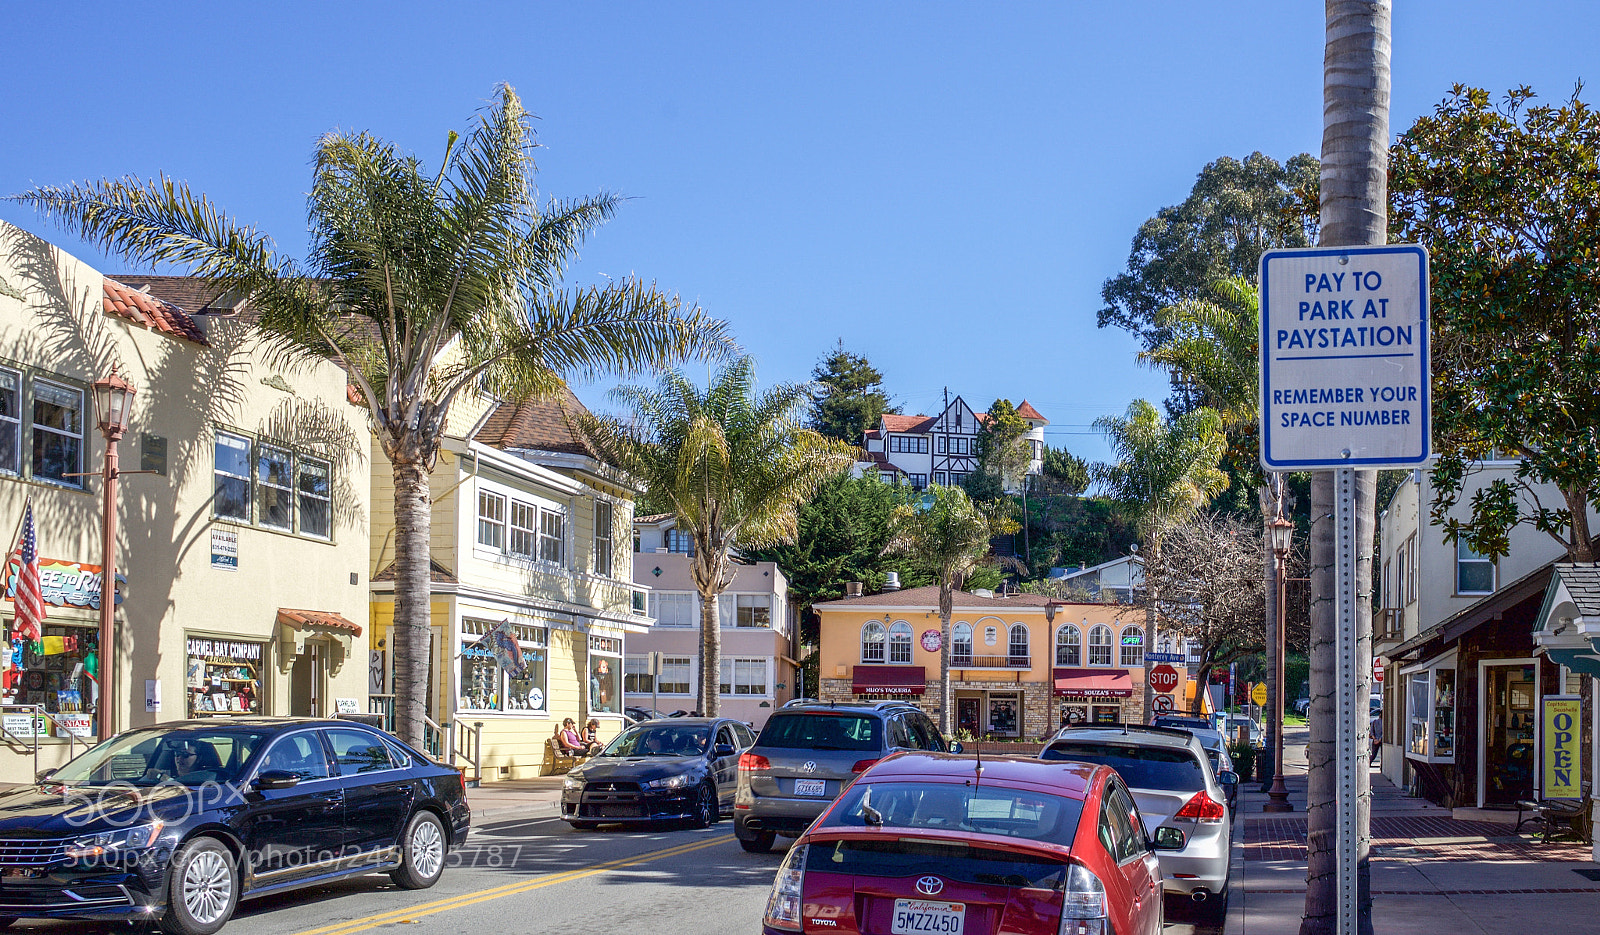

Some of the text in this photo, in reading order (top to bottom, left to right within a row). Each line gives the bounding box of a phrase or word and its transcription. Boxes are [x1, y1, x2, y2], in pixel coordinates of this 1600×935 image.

[1305, 271, 1382, 293] PAY TO
[1299, 298, 1389, 321] PARK AT
[1277, 325, 1412, 349] PAYSTATION
[1273, 386, 1417, 404] REMEMBER YOUR
[1281, 410, 1410, 427] SPACE NUMBER
[61, 574, 77, 585] TO
[41, 589, 101, 603] URF SHO
[187, 639, 260, 659] CARMEL BAY COMPANY
[1145, 653, 1168, 661] Monterey
[1150, 672, 1177, 684] STOP
[1553, 713, 1572, 786] OPEN
[909, 902, 952, 913] California
[812, 918, 837, 926] TOYOTA
[897, 912, 959, 932] 5MZZ450
